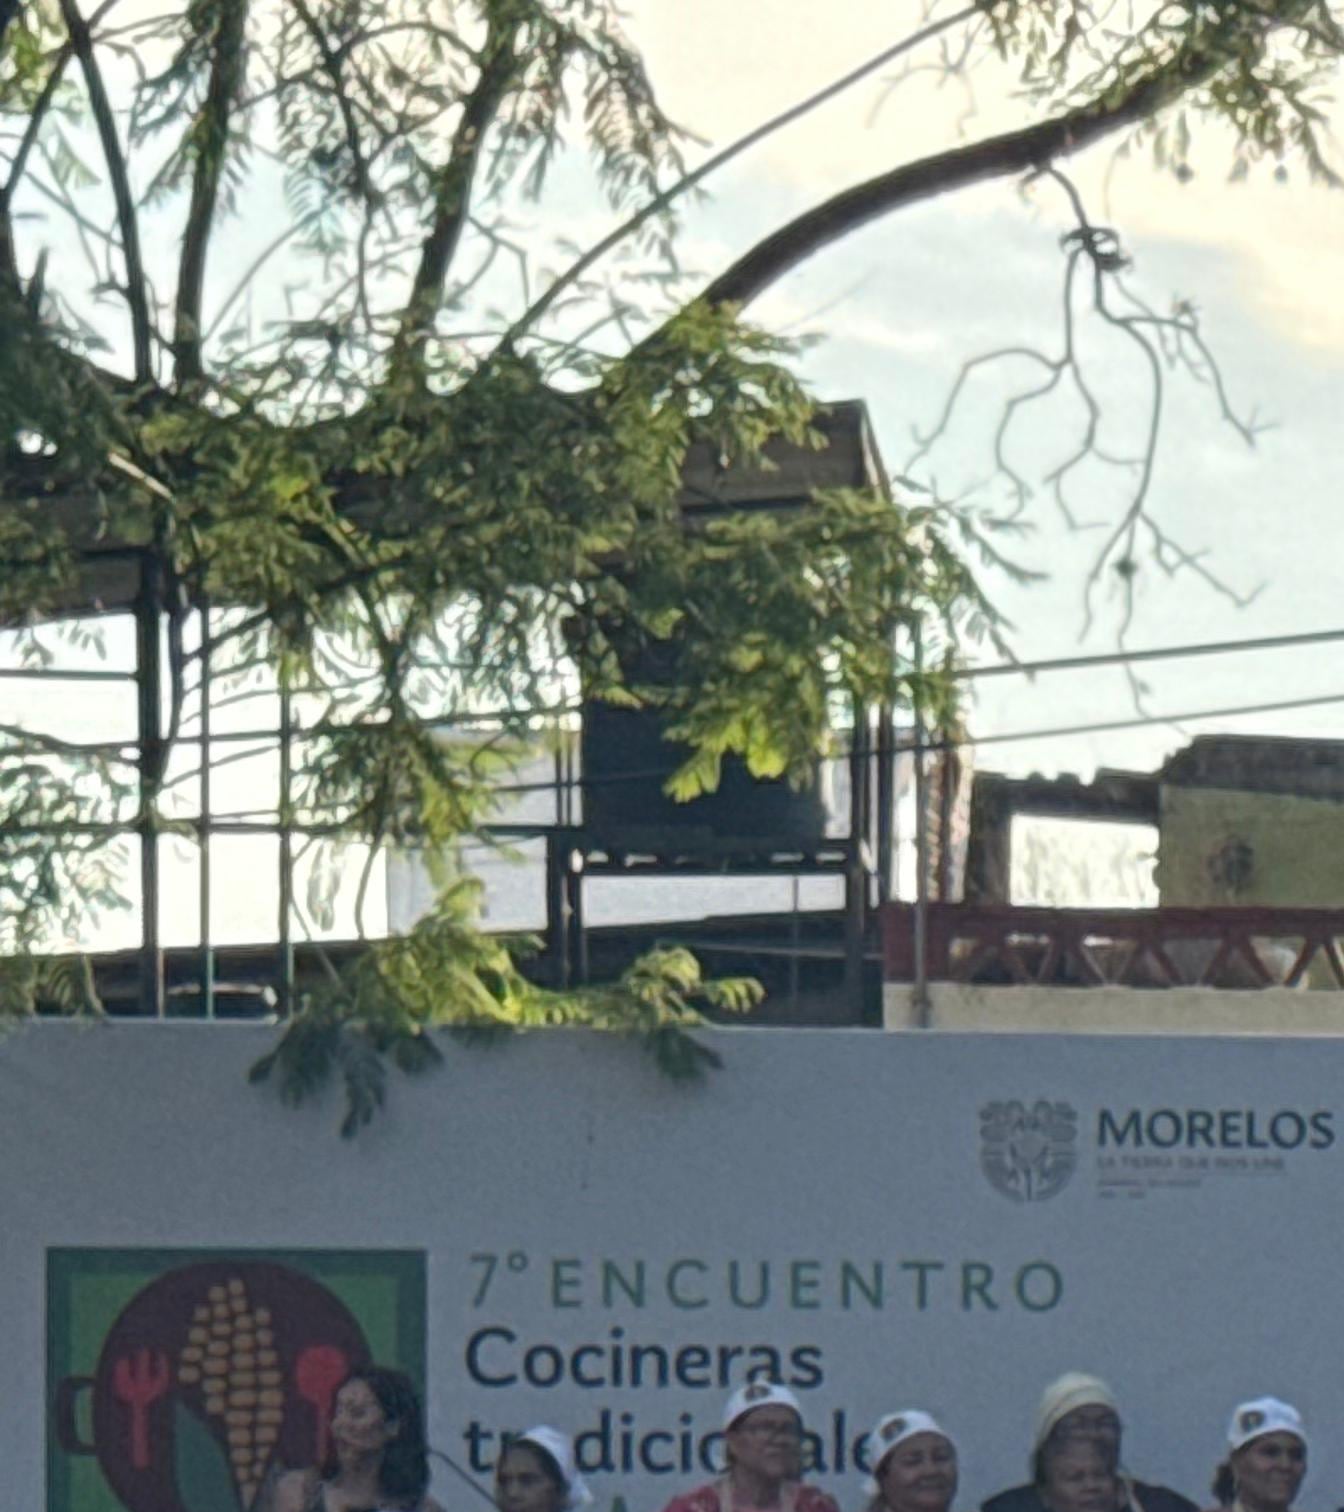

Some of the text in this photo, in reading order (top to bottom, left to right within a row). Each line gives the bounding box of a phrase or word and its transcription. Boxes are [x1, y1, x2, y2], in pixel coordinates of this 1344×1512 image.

[1097, 1109, 1335, 1150] MORELOS
[550, 1257, 1064, 1312] ENCUENTRO
[464, 1325, 824, 1388] Cocineras
